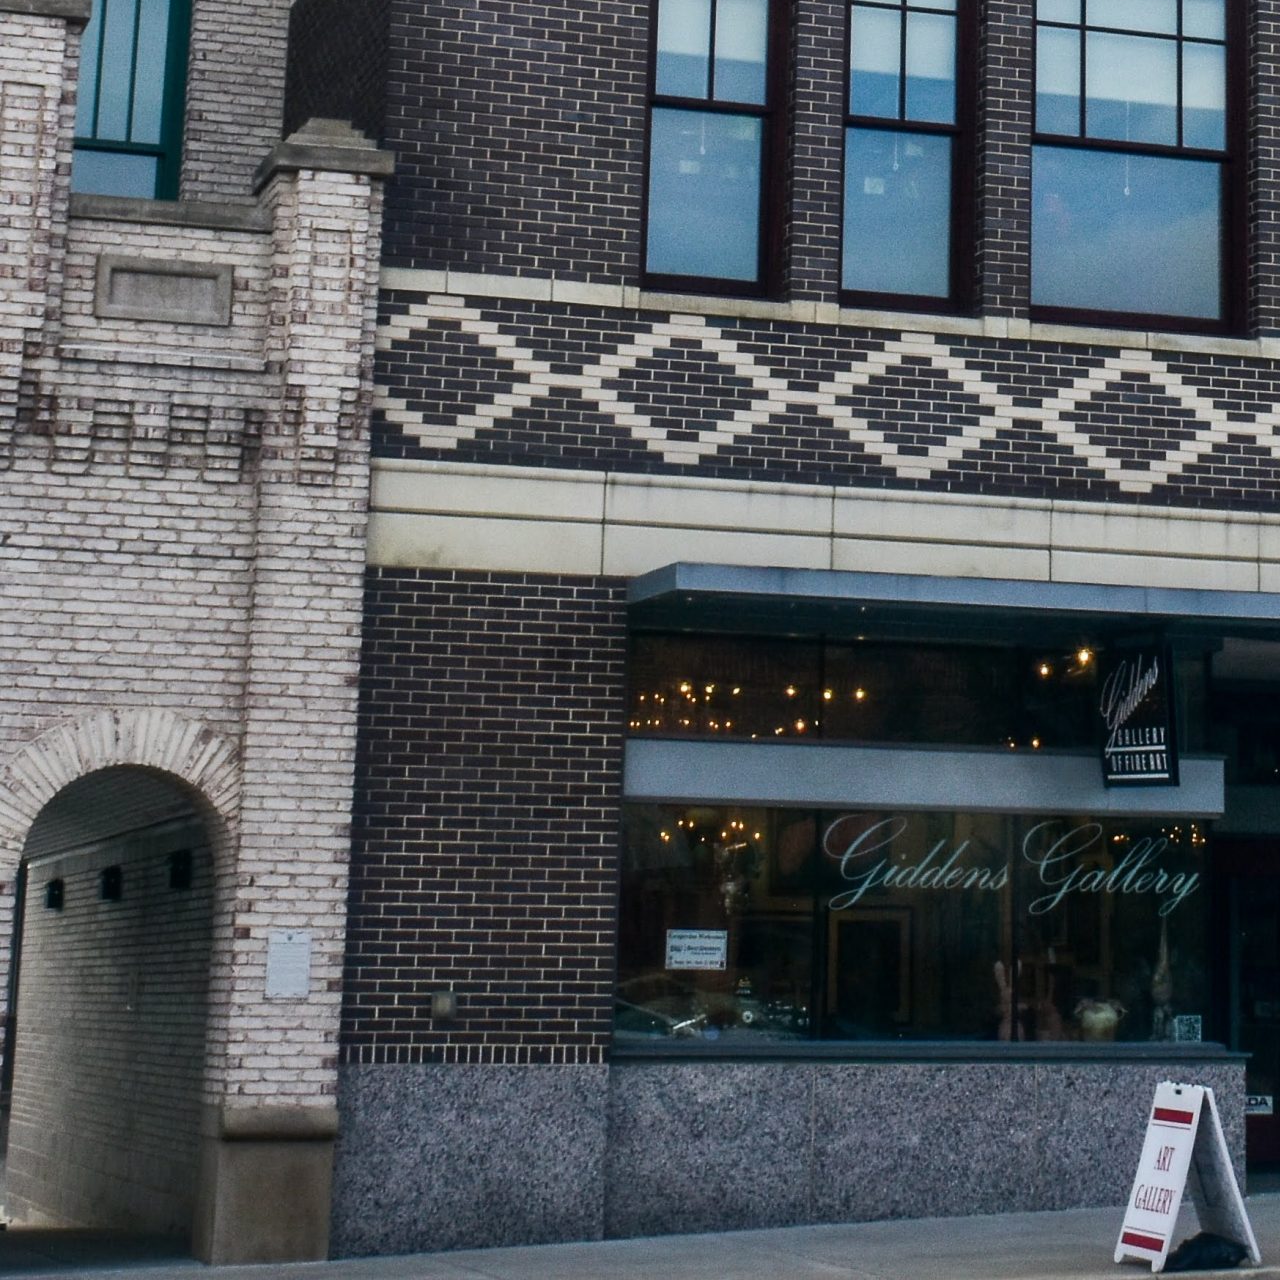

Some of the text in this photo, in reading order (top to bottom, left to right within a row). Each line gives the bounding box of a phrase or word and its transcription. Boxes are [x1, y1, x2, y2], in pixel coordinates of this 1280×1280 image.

[1100, 654, 1158, 758] Giddens
[1117, 727, 1165, 745] GALLERY
[1148, 752, 1168, 771] ART
[823, 813, 1201, 917] Giddens Gallery
[1245, 1097, 1269, 1107] DA
[1153, 1145, 1176, 1172] ART
[1134, 1183, 1177, 1215] GALLERY
